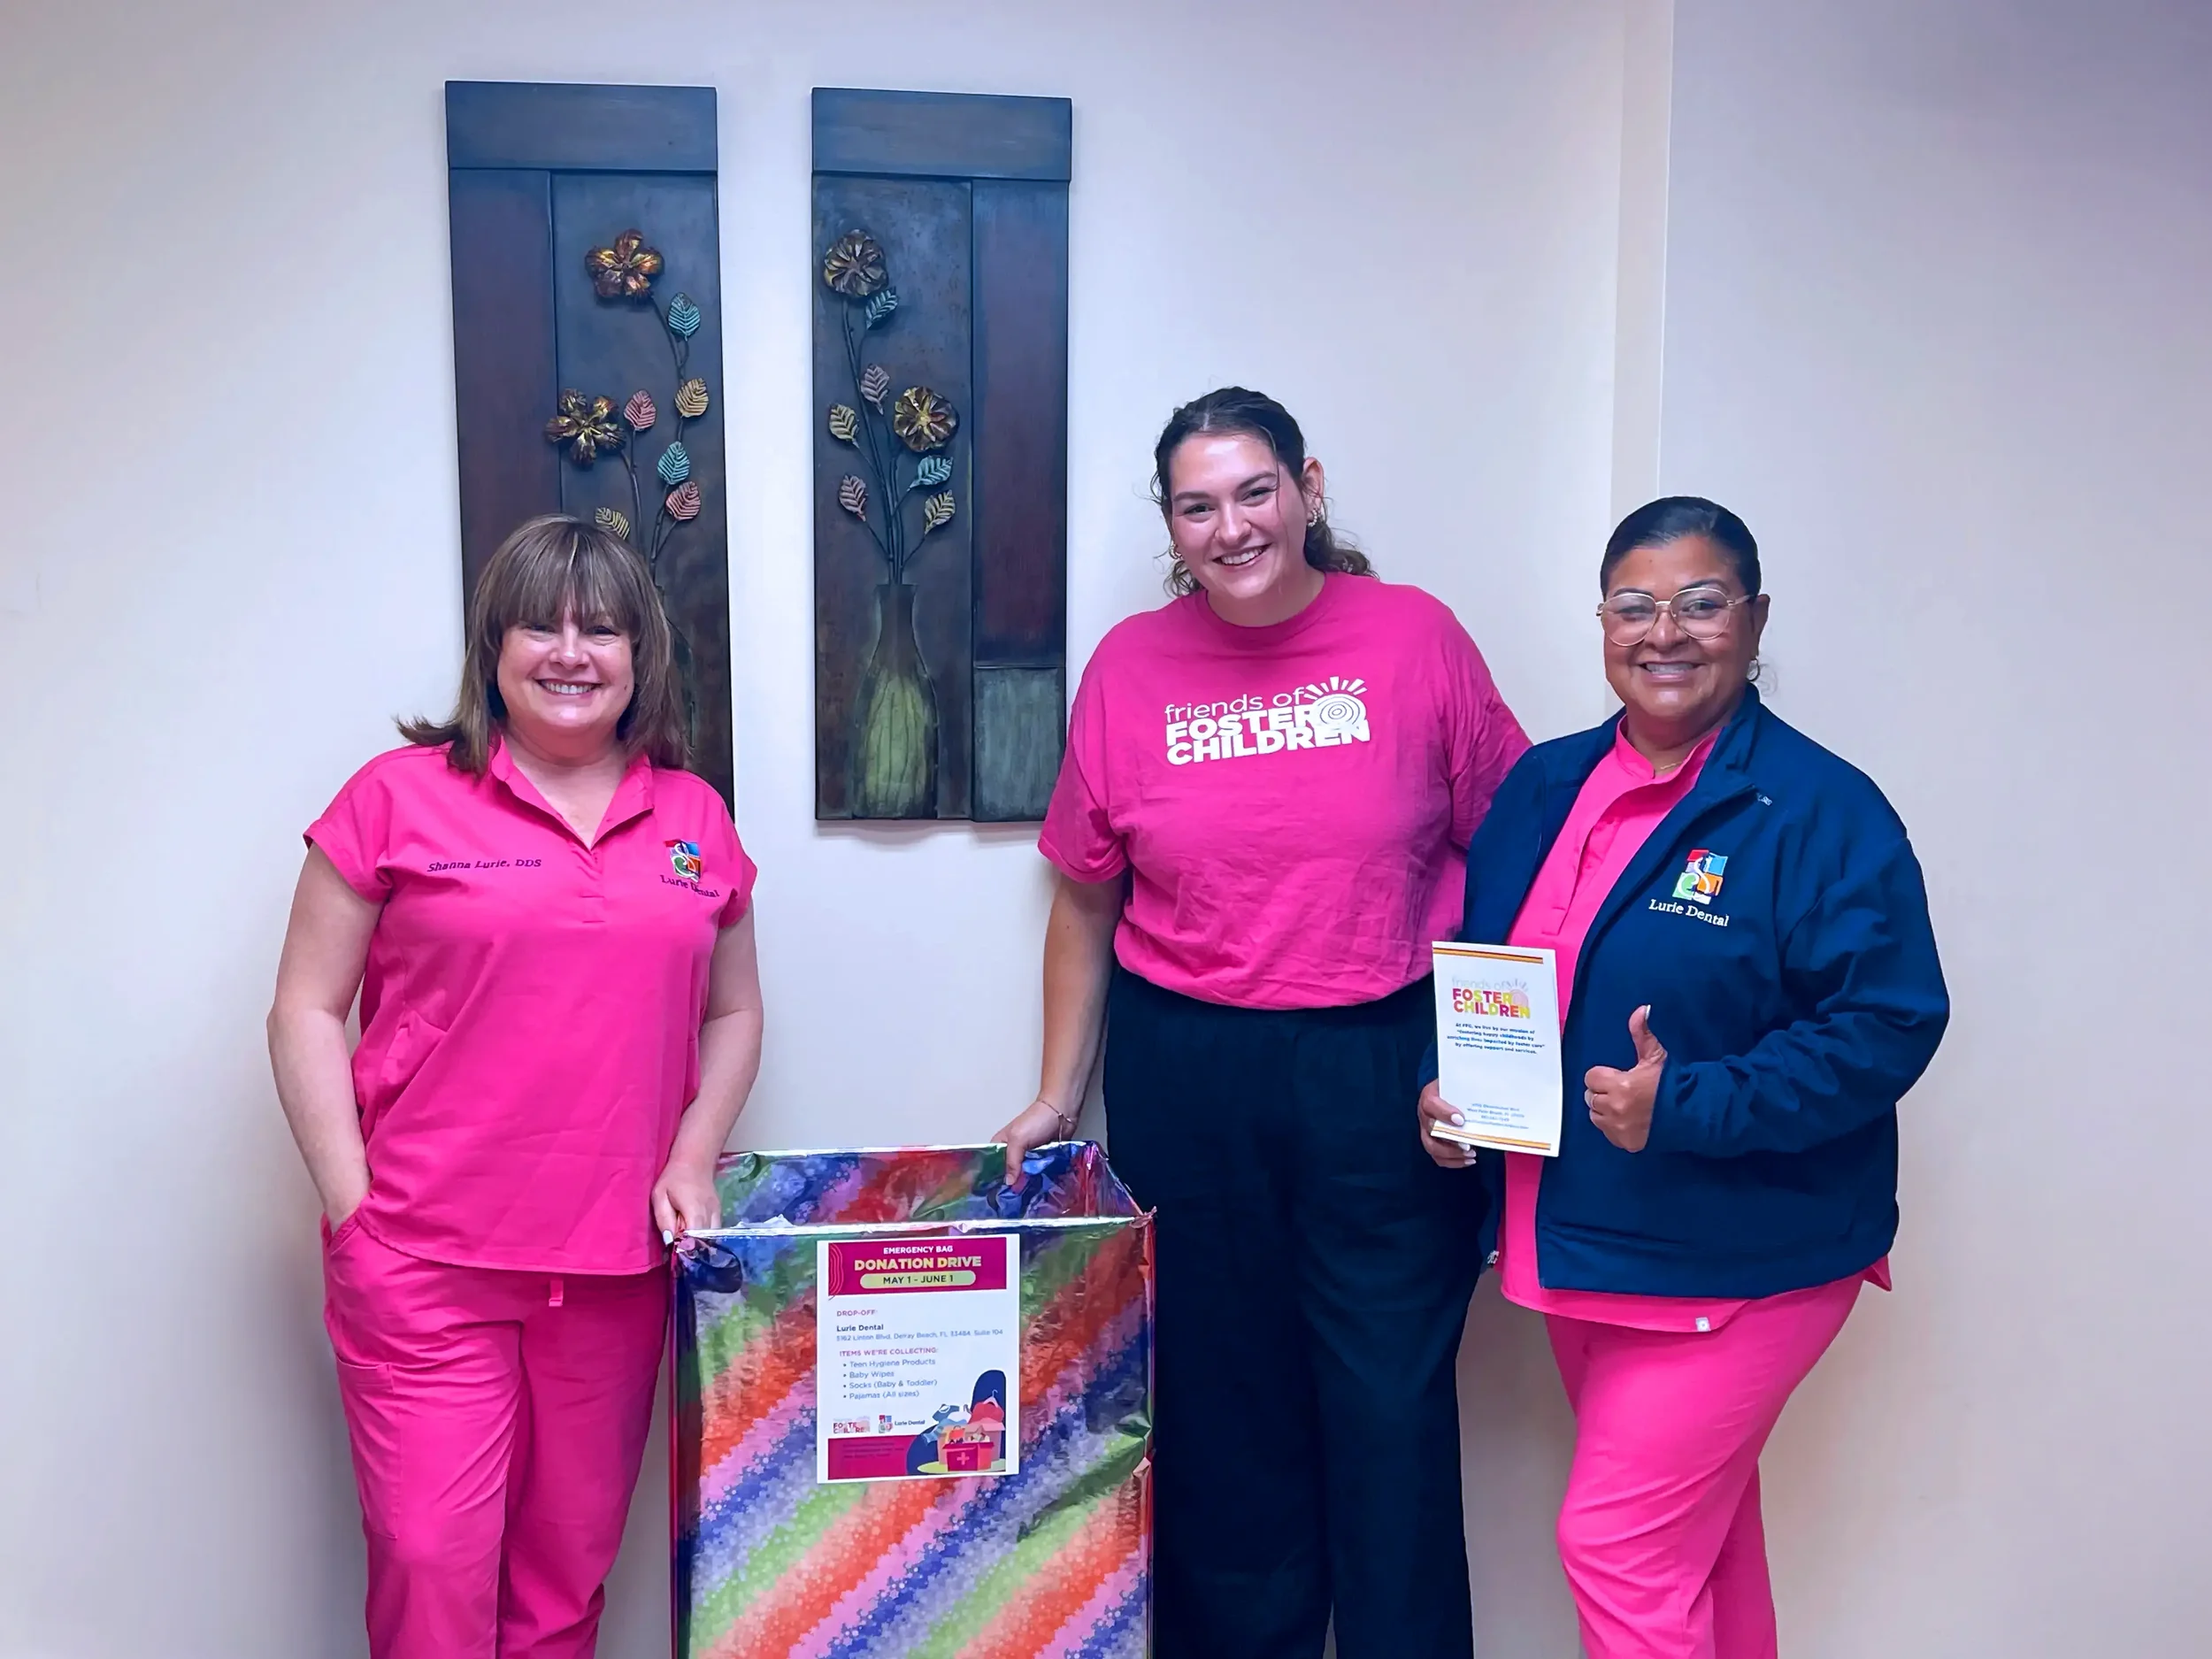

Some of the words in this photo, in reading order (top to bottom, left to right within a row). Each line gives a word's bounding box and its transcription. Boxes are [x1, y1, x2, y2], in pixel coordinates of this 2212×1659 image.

[1164, 693, 1263, 724] friends
[1272, 687, 1305, 708] of
[1166, 704, 1317, 747] FOSTER
[1166, 719, 1371, 766] CHILDREN
[426, 861, 471, 872] Shanna
[515, 858, 542, 867] DDS
[660, 874, 688, 888] Lurie
[1648, 899, 1685, 914] Lurie
[1686, 905, 1730, 926] Dental
[1452, 976, 1491, 989] friends
[1452, 987, 1513, 1004] FOSTER
[1453, 1000, 1531, 1019] CHILDREN
[883, 1246, 934, 1255] EMERGENCY
[854, 1257, 934, 1271] DONATION
[936, 1256, 982, 1269] DRIVE
[883, 1276, 904, 1285] MAY
[869, 1359, 900, 1369] Hygiene
[873, 1379, 896, 1389] (Baby
[906, 1379, 938, 1387] Toddler)
[882, 1390, 896, 1399] (All
[897, 1389, 920, 1398] sizes)
